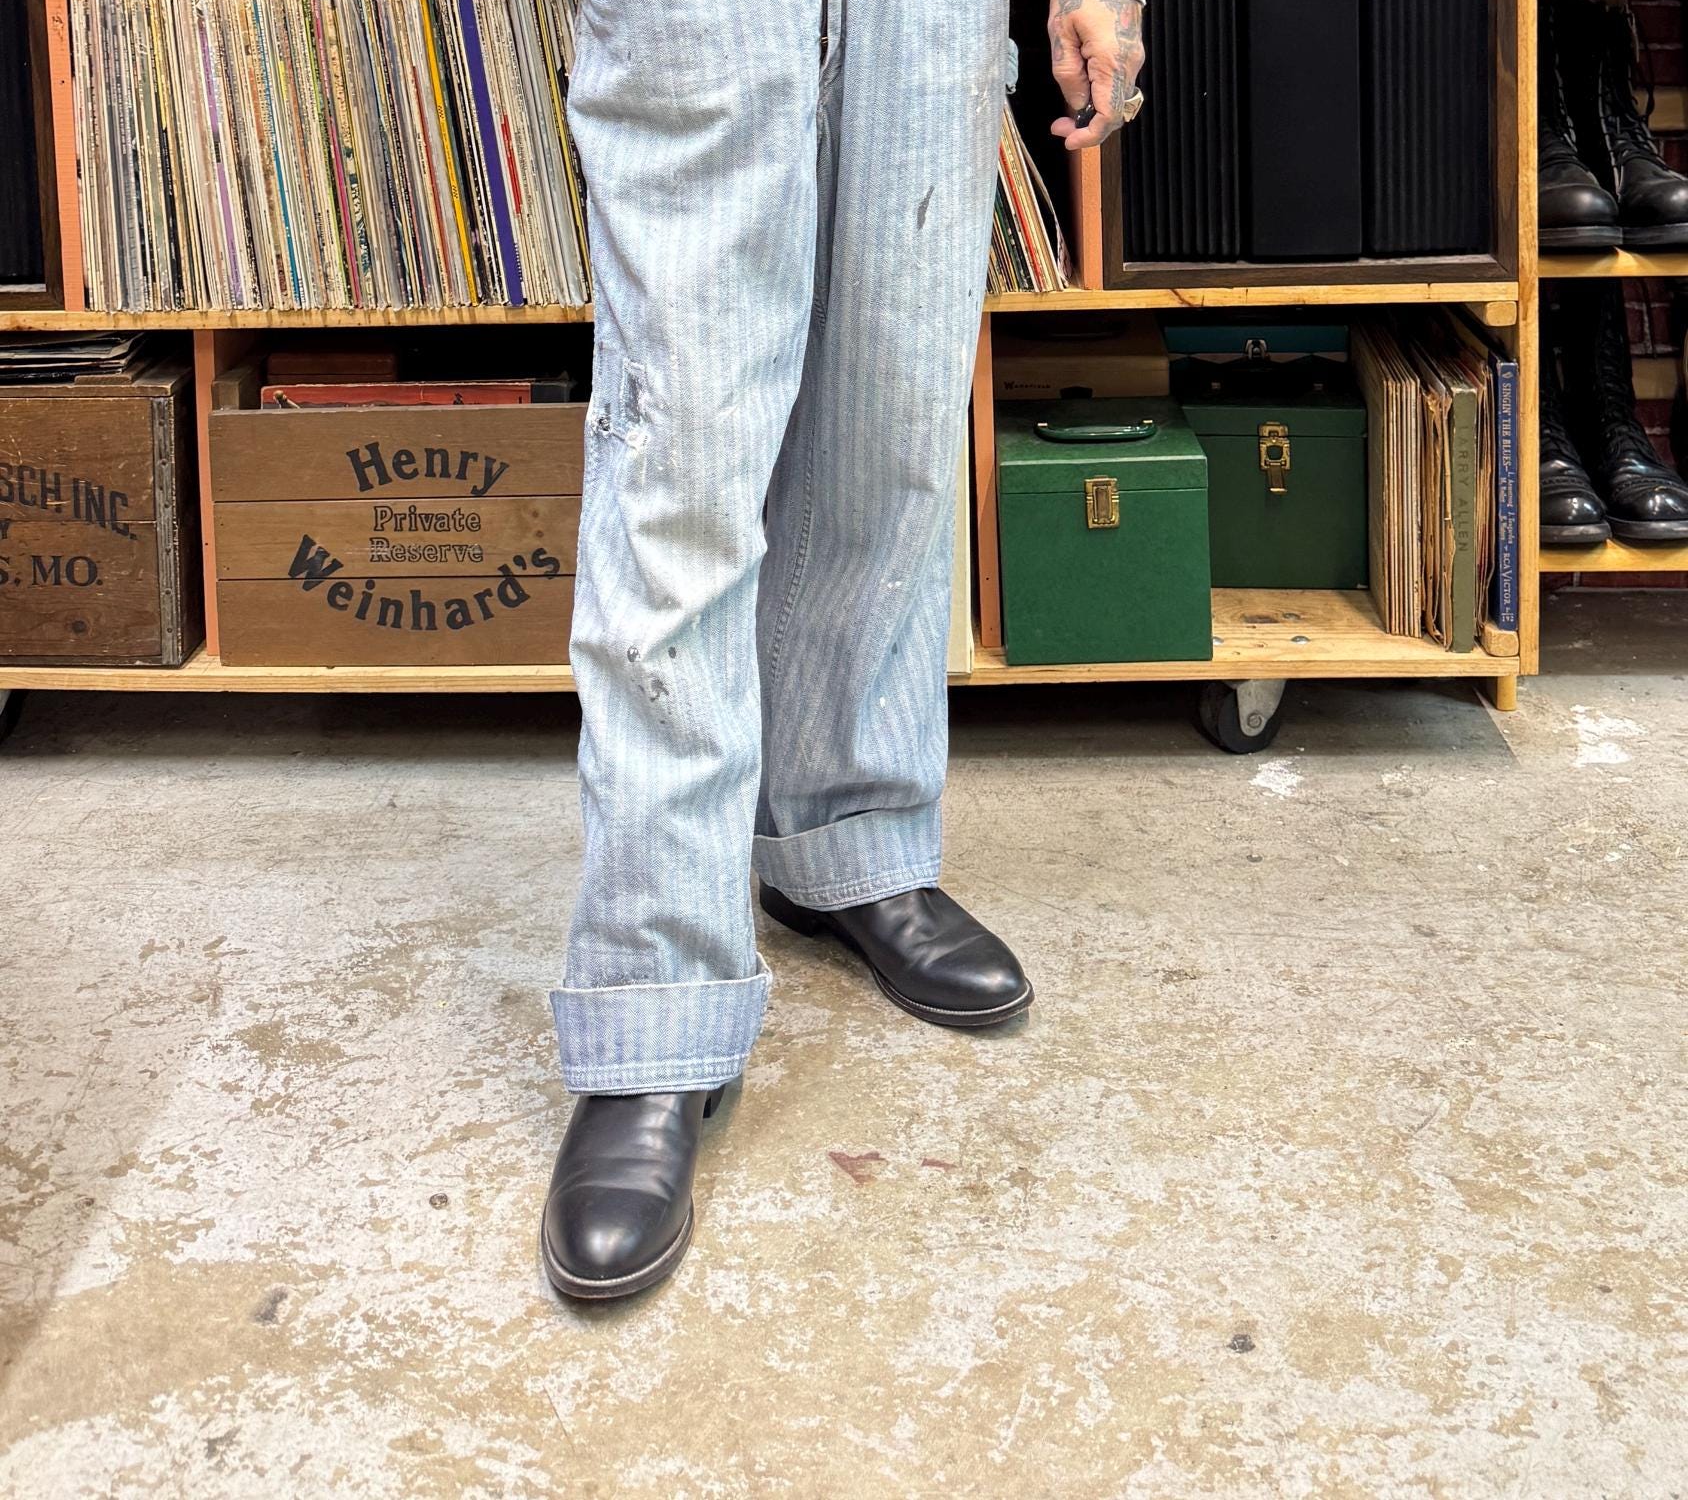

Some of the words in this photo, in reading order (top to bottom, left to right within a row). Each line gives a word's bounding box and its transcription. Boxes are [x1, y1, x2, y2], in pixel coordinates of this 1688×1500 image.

[1502, 382, 1512, 416] SINGIN'
[1502, 418, 1512, 437] THE
[346, 441, 510, 497] Henry
[1458, 425, 1469, 487] LARRY
[72, 477, 138, 541] INC.
[373, 504, 482, 533] Private
[1458, 498, 1469, 552] ALLEN
[369, 536, 484, 564] Reserve
[1503, 552, 1511, 569] RCA
[31, 555, 104, 587] MO.
[288, 533, 561, 631] Weinhard's
